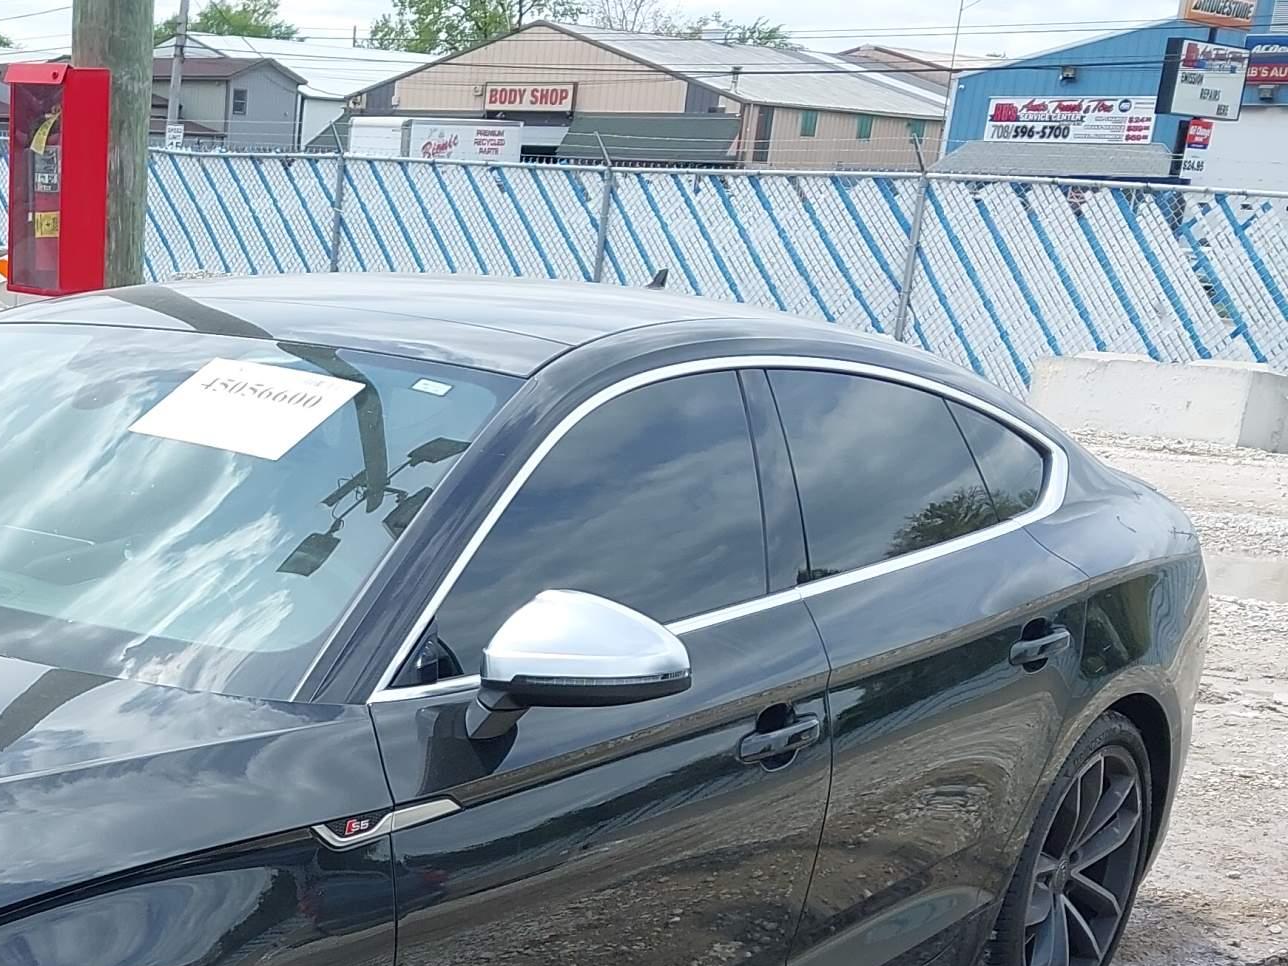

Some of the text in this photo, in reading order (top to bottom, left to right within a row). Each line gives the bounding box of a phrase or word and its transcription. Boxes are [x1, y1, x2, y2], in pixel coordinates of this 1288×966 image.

[488, 88, 569, 106] BODY SHOP
[1019, 112, 1082, 122] SERVICE CENTER
[476, 129, 505, 137] PREMIUM
[990, 125, 1071, 140] 708/596-5700
[474, 138, 505, 146] RECYCLED
[200, 377, 323, 409] 45056600
